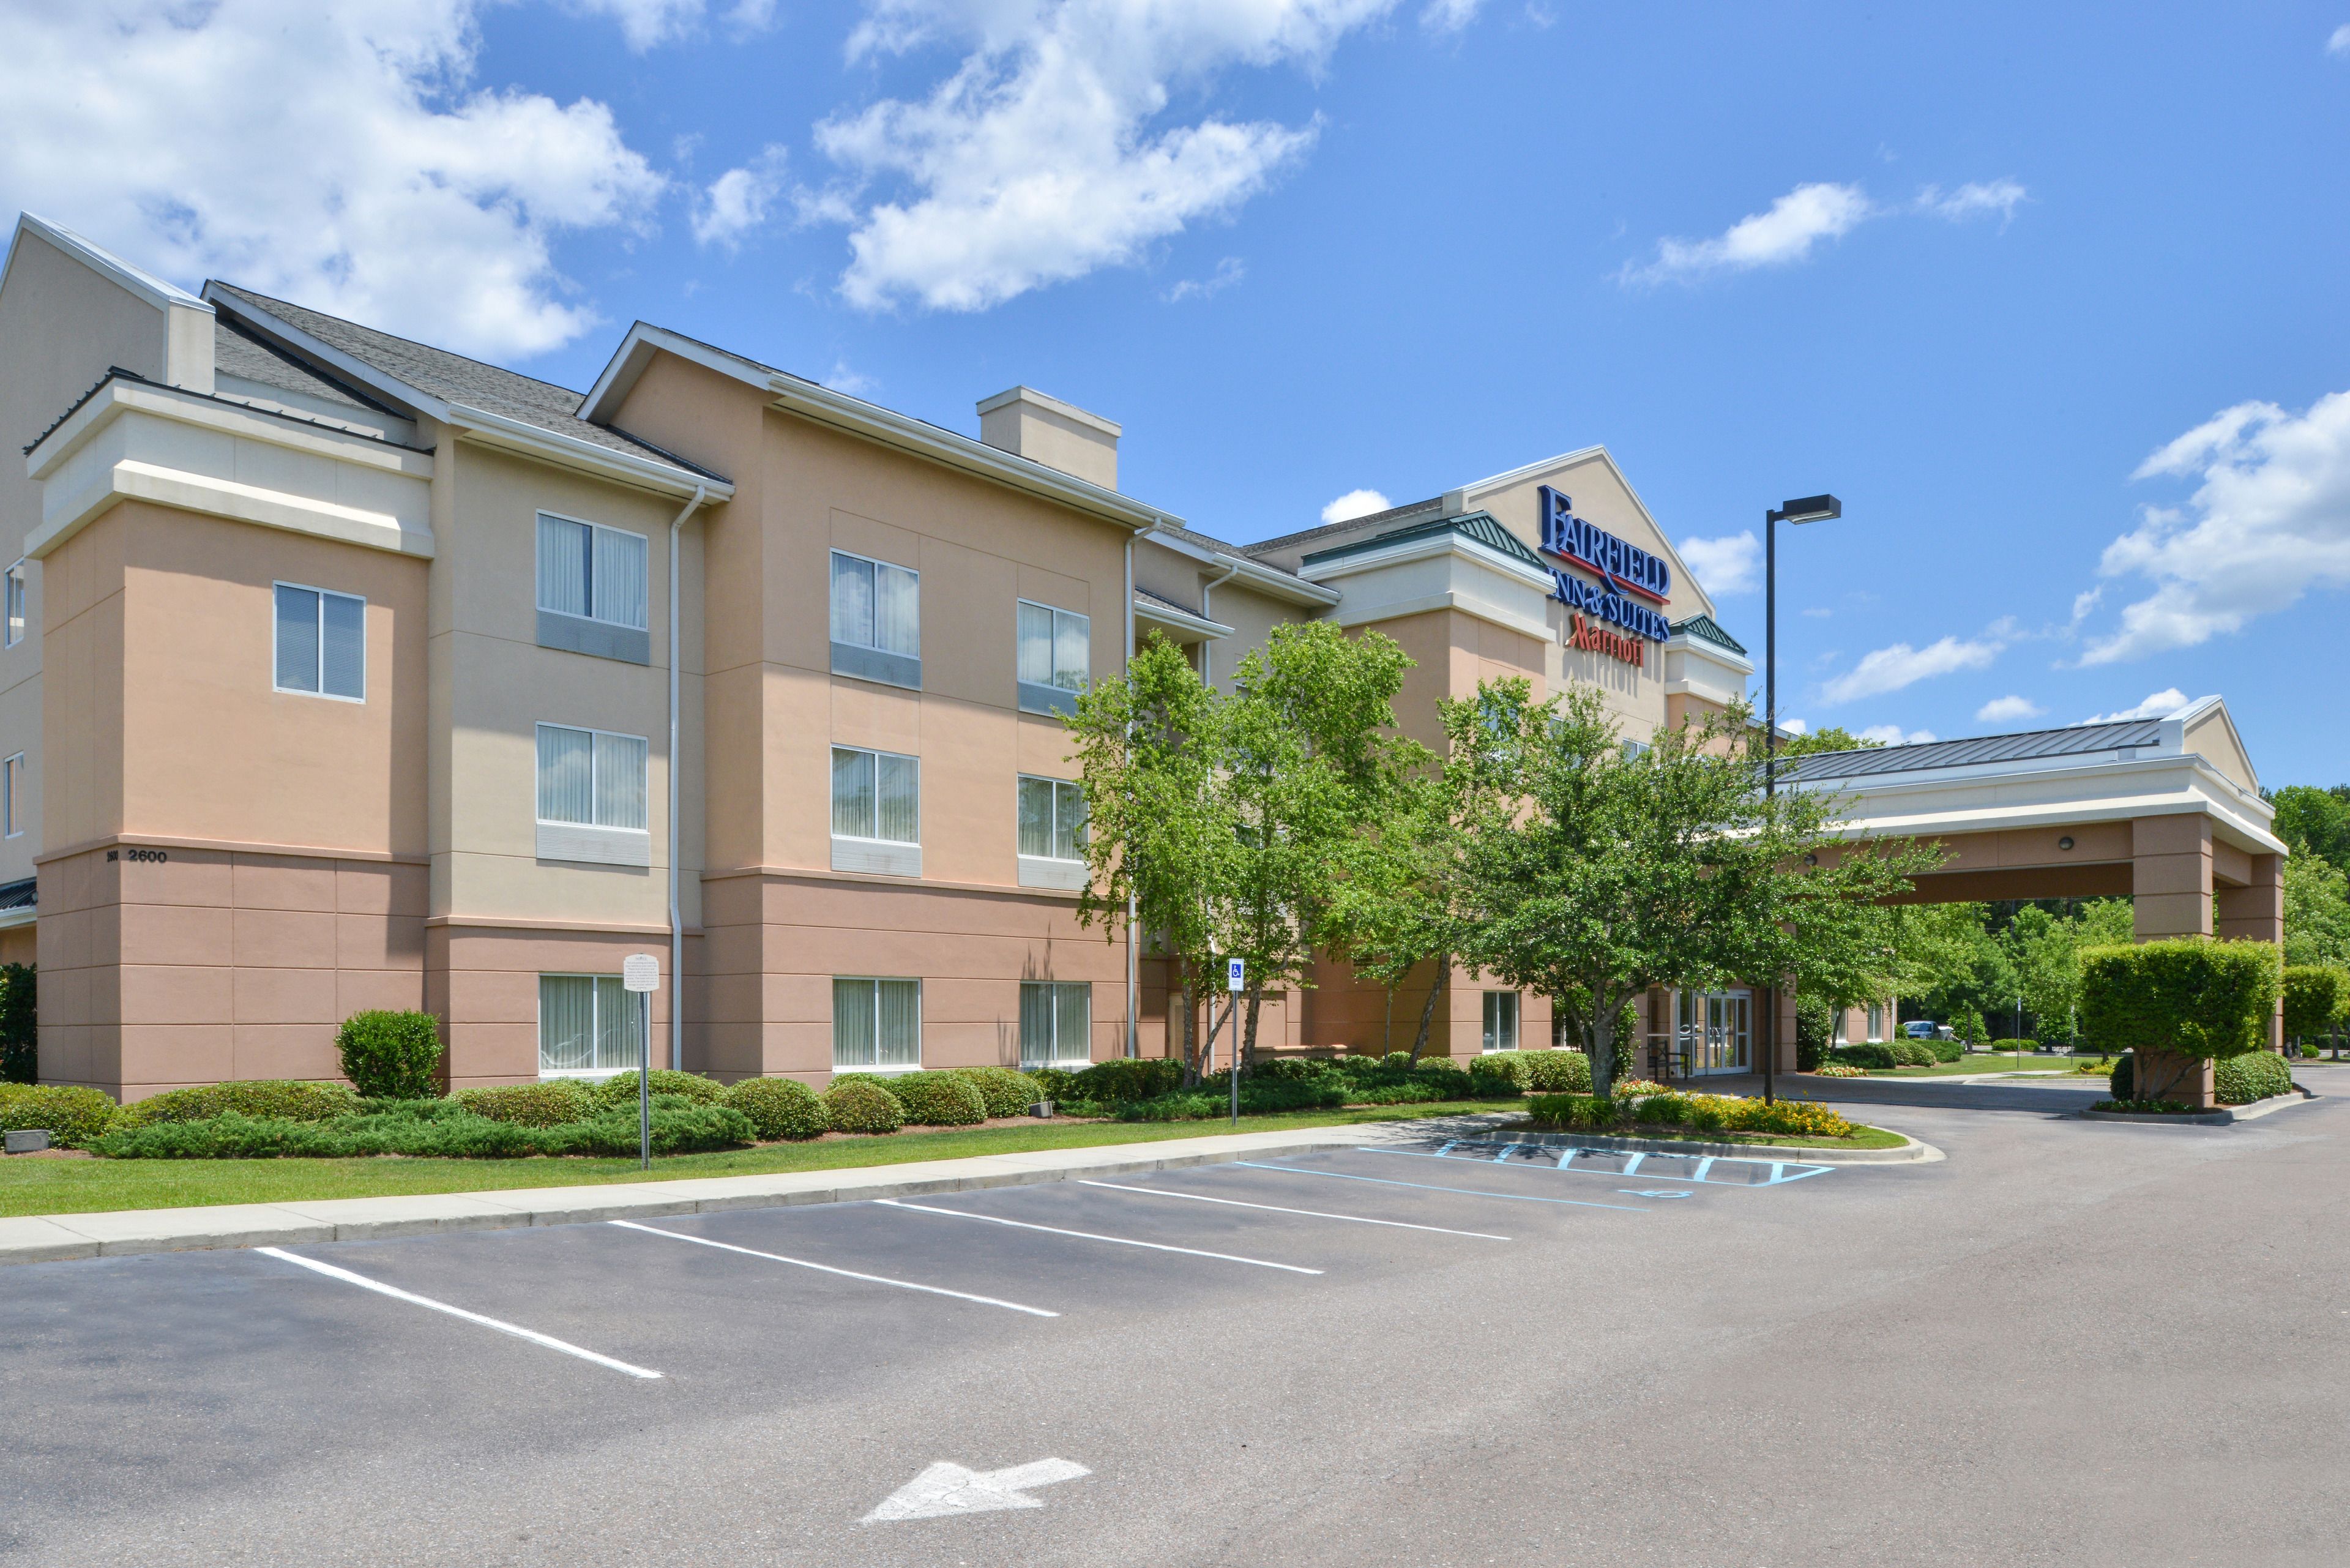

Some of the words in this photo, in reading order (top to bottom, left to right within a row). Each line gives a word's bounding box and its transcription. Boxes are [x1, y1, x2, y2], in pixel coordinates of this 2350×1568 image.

[1537, 485, 1671, 595] FAIRFIELD
[1565, 611, 1644, 668] Marriott
[1584, 586, 1604, 616] &
[1601, 592, 1671, 643] SUITES
[128, 849, 167, 864] 2600
